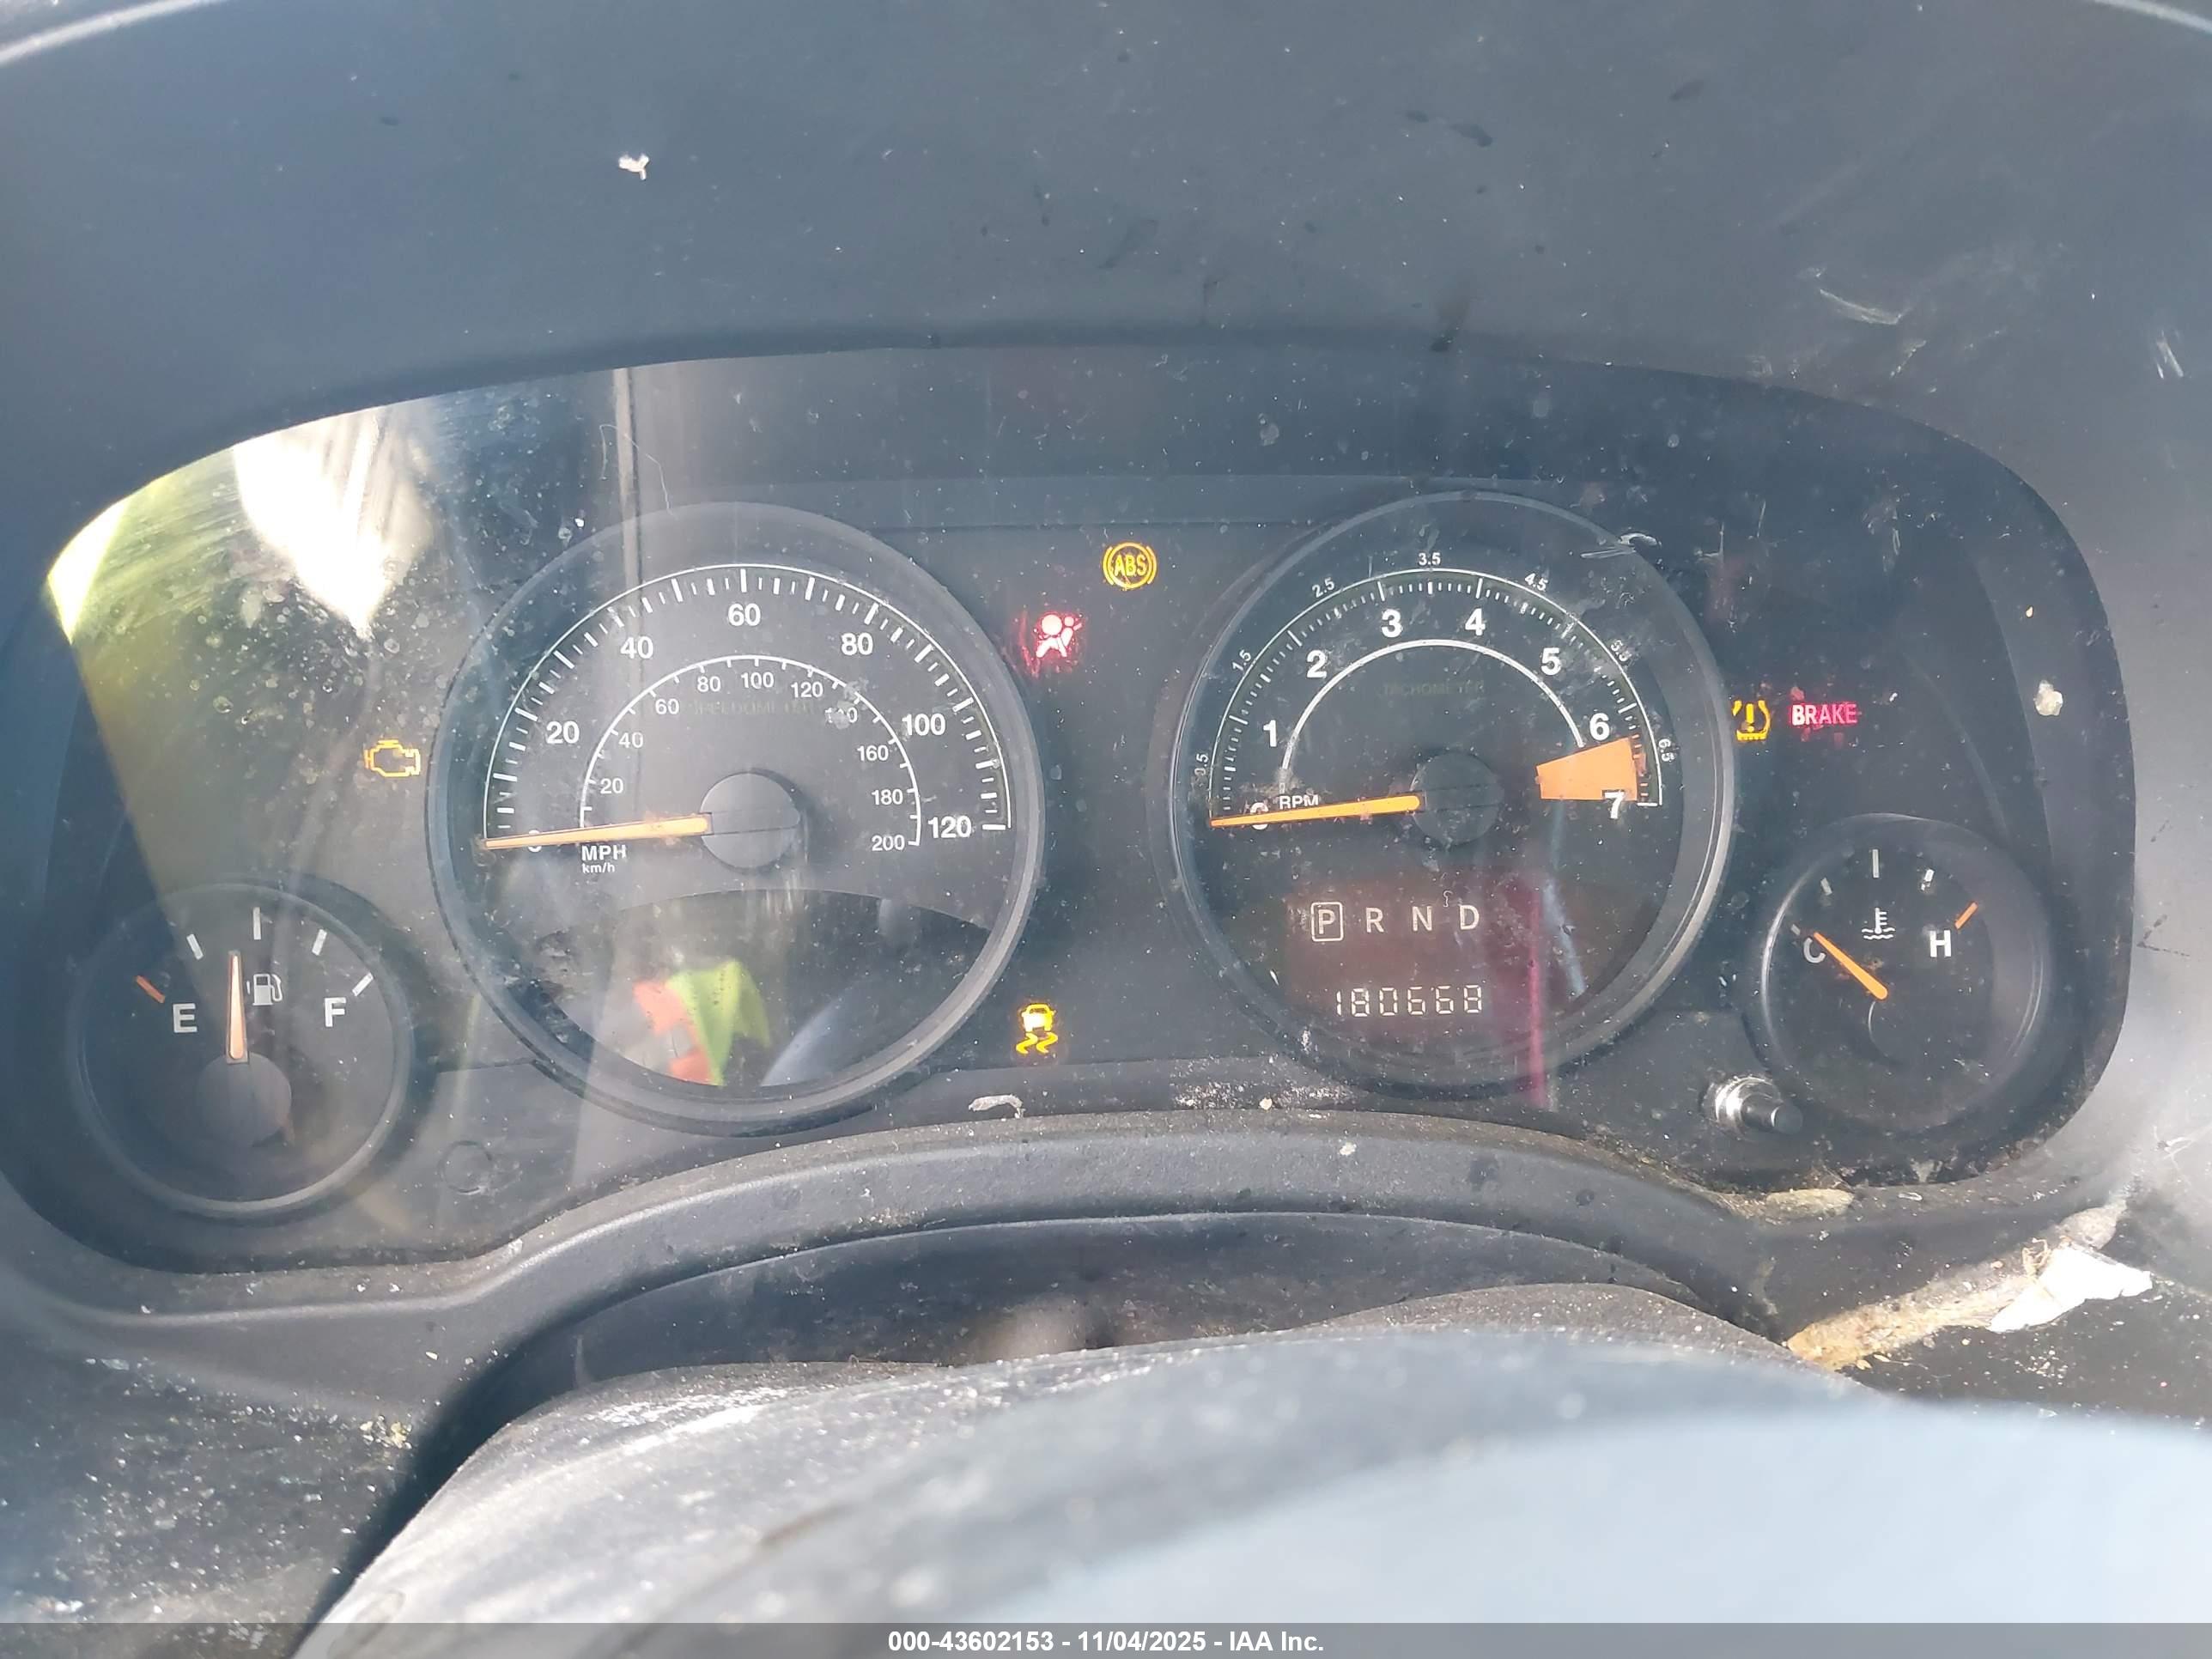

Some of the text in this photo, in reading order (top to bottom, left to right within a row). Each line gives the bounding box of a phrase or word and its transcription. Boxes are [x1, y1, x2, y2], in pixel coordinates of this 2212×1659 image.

[1115, 554, 1147, 576] ABS
[1419, 552, 1441, 566] 3.5
[1312, 578, 1335, 598] 2.5
[1524, 572, 1548, 592] 4.5
[728, 604, 761, 626] 60
[1382, 609, 1403, 637] 3
[1465, 609, 1486, 636] 4
[620, 636, 653, 659] 40
[842, 633, 873, 655] 80
[1232, 650, 1252, 672] 1.5
[1306, 650, 1327, 678] 2
[1541, 647, 1560, 675] 5
[697, 677, 721, 692] 80
[741, 672, 774, 689] 100
[791, 682, 823, 698] 120
[655, 699, 680, 714] 60
[825, 708, 857, 723] 10
[1791, 703, 1857, 726] BRAKE
[546, 721, 579, 744] 20
[902, 714, 945, 736] 100
[1263, 720, 1277, 747] 1
[1589, 713, 1610, 740] 6
[619, 732, 644, 748] 40
[1658, 738, 1674, 763] 6.5
[858, 745, 889, 762] 160
[600, 778, 624, 794] 20
[872, 789, 903, 805] 180
[1279, 794, 1319, 810] RPM
[1602, 790, 1625, 819] 7
[927, 816, 972, 839] 120
[581, 845, 626, 860] MPH
[872, 836, 905, 852] 200
[582, 862, 616, 873] km/h
[1318, 904, 1480, 934] P R N D
[1803, 937, 1826, 963] C
[1929, 929, 1951, 957] H
[325, 997, 346, 1027] F
[1336, 985, 1482, 1018] 180668
[173, 1003, 197, 1033] E
